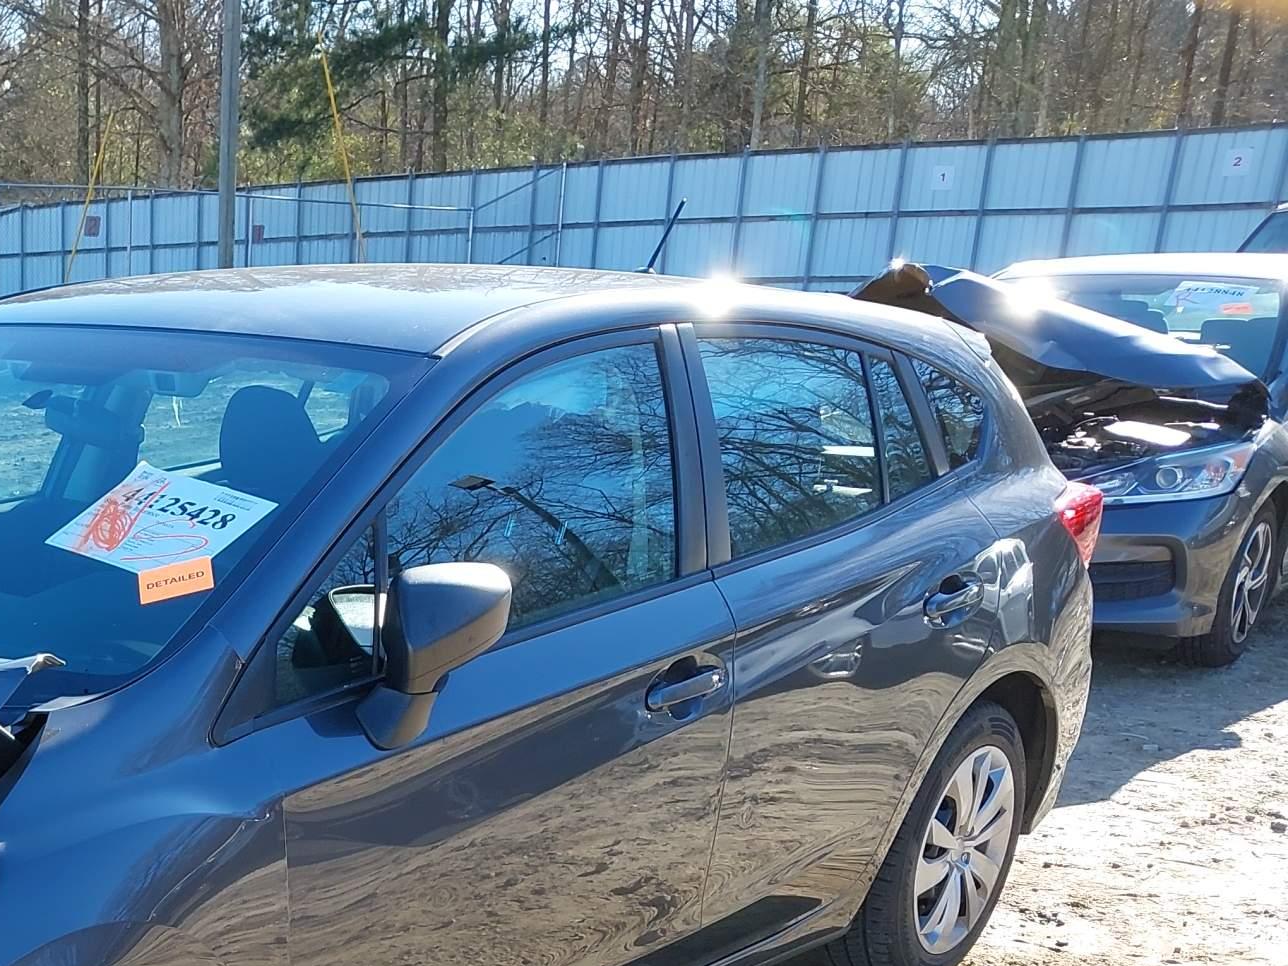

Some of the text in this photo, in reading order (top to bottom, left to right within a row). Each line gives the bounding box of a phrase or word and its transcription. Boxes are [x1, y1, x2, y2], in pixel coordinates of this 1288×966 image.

[1232, 156, 1242, 167] 2
[939, 172, 946, 182] 1
[122, 487, 236, 530] 44125428
[146, 570, 205, 590] DETAILED
